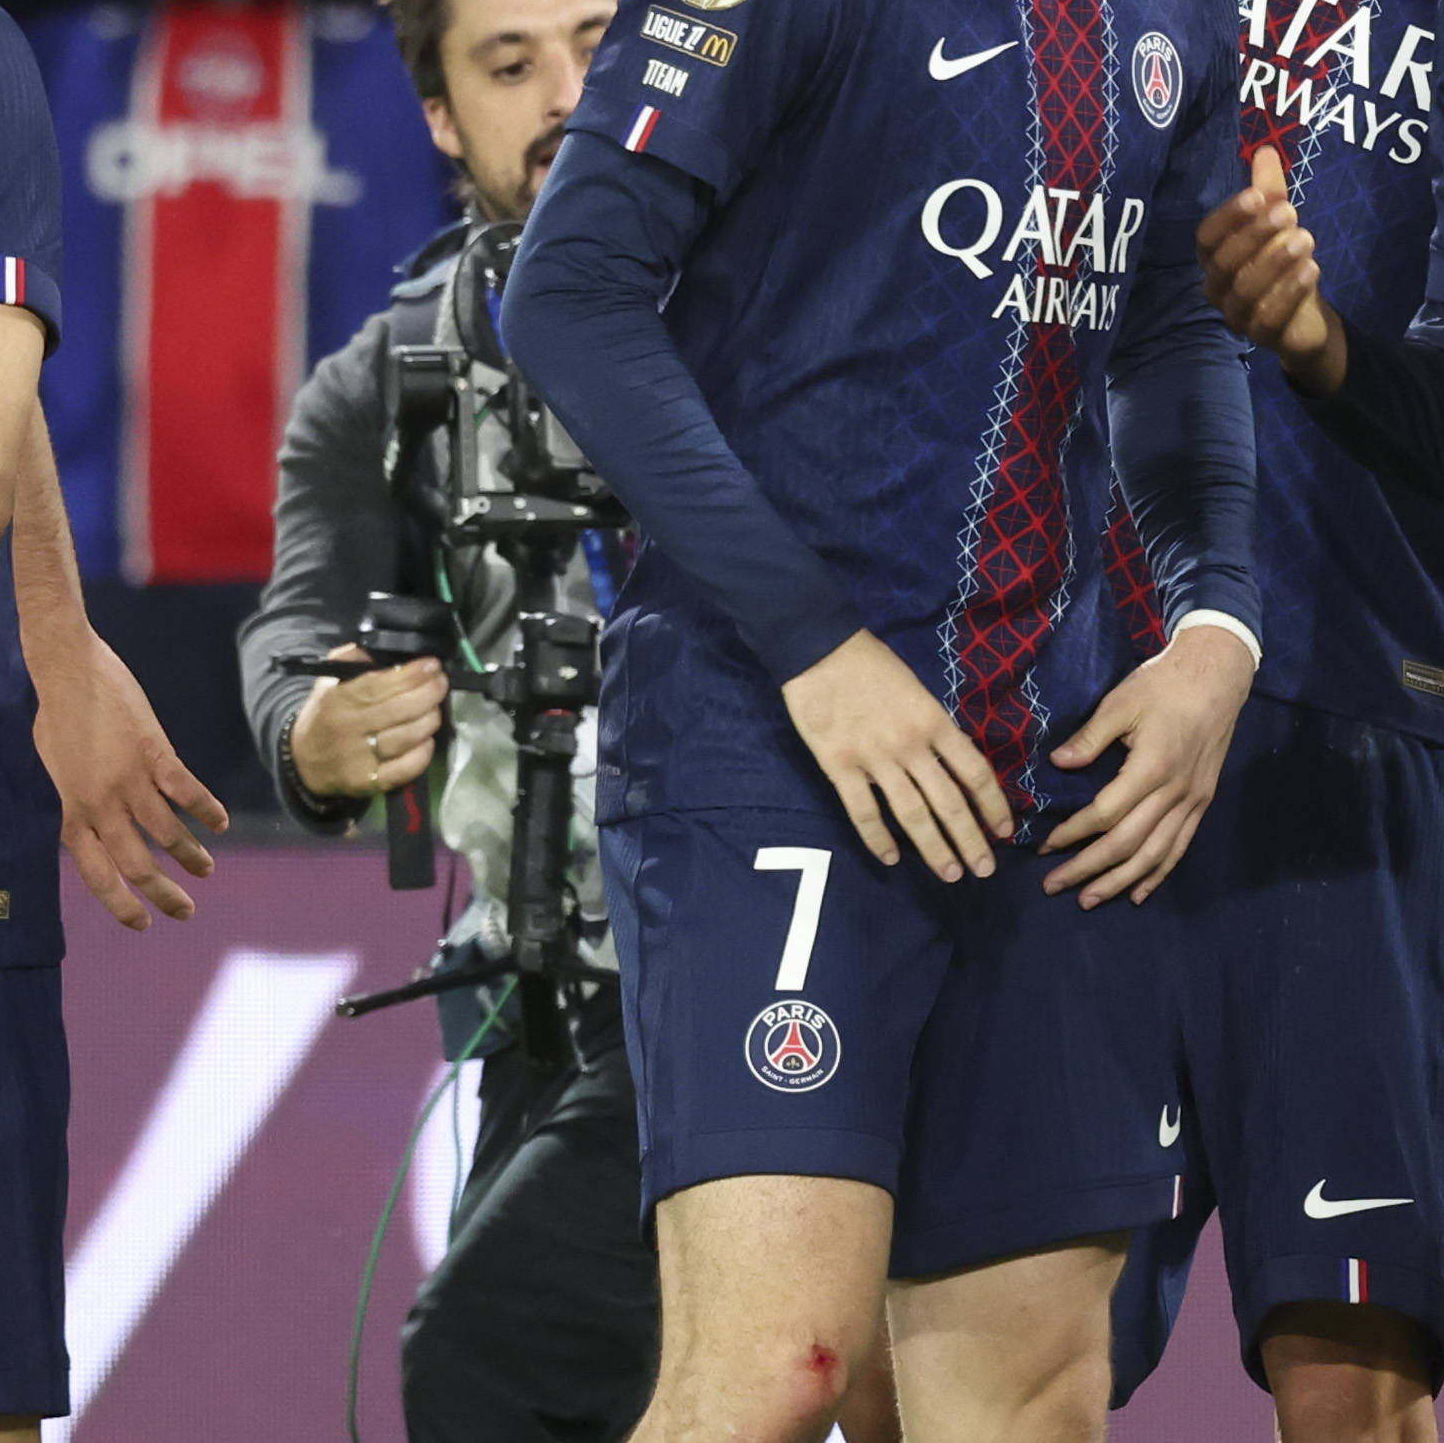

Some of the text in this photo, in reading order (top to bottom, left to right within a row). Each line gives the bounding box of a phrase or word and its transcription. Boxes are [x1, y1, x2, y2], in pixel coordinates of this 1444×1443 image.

[642, 11, 689, 49] LIGUE
[1138, 36, 1173, 62] PARIS
[1239, 58, 1429, 164] RWAYS
[921, 178, 1145, 279] QATAR
[753, 846, 832, 991] 7
[762, 1004, 826, 1029] PARIS
[761, 1065, 783, 1083] SAINT
